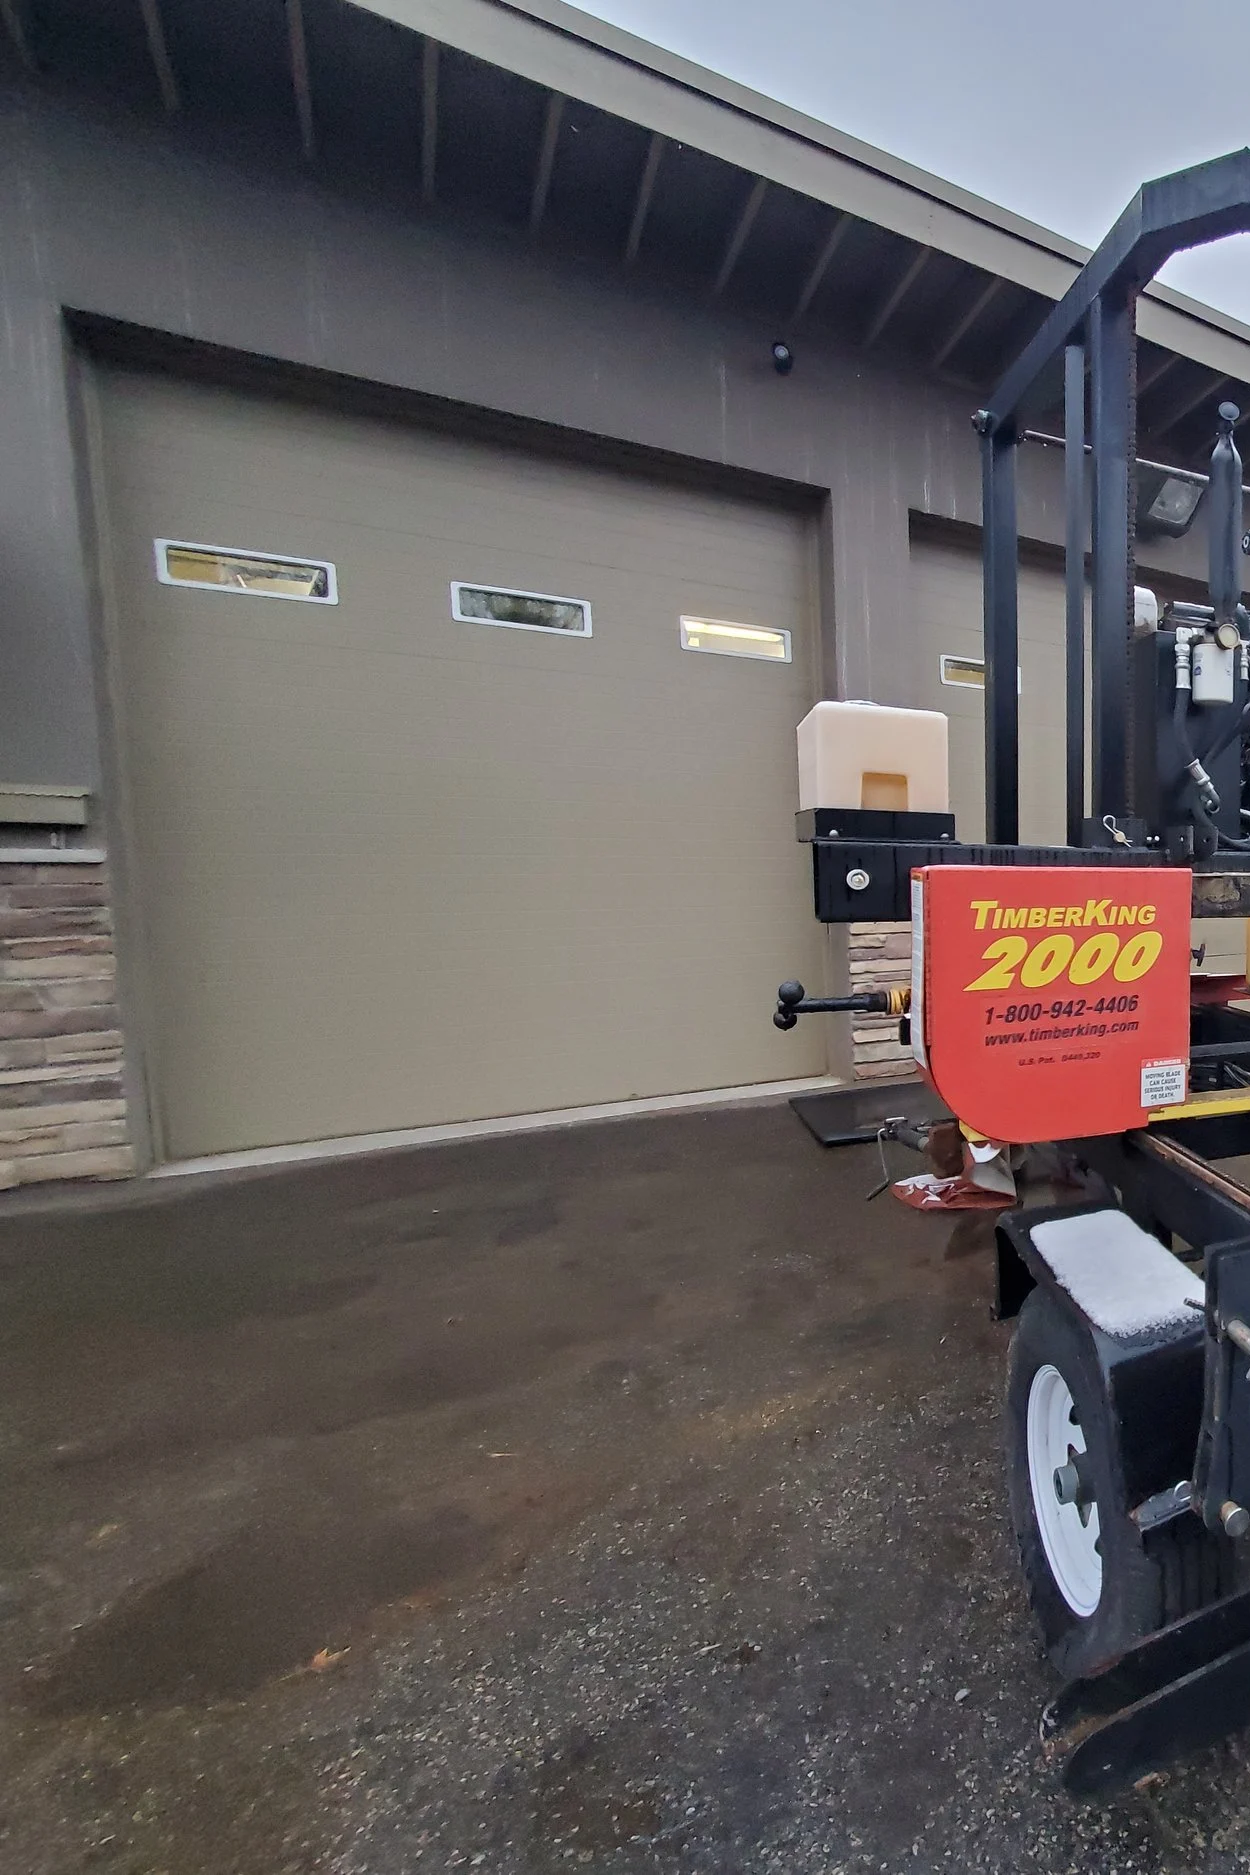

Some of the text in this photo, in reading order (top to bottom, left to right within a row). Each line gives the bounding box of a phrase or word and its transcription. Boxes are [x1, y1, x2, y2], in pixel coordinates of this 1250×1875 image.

[962, 931, 1163, 992] 2000
[985, 994, 1139, 1026] 1-800-942-4406
[985, 1020, 1139, 1047] www.timberking.com
